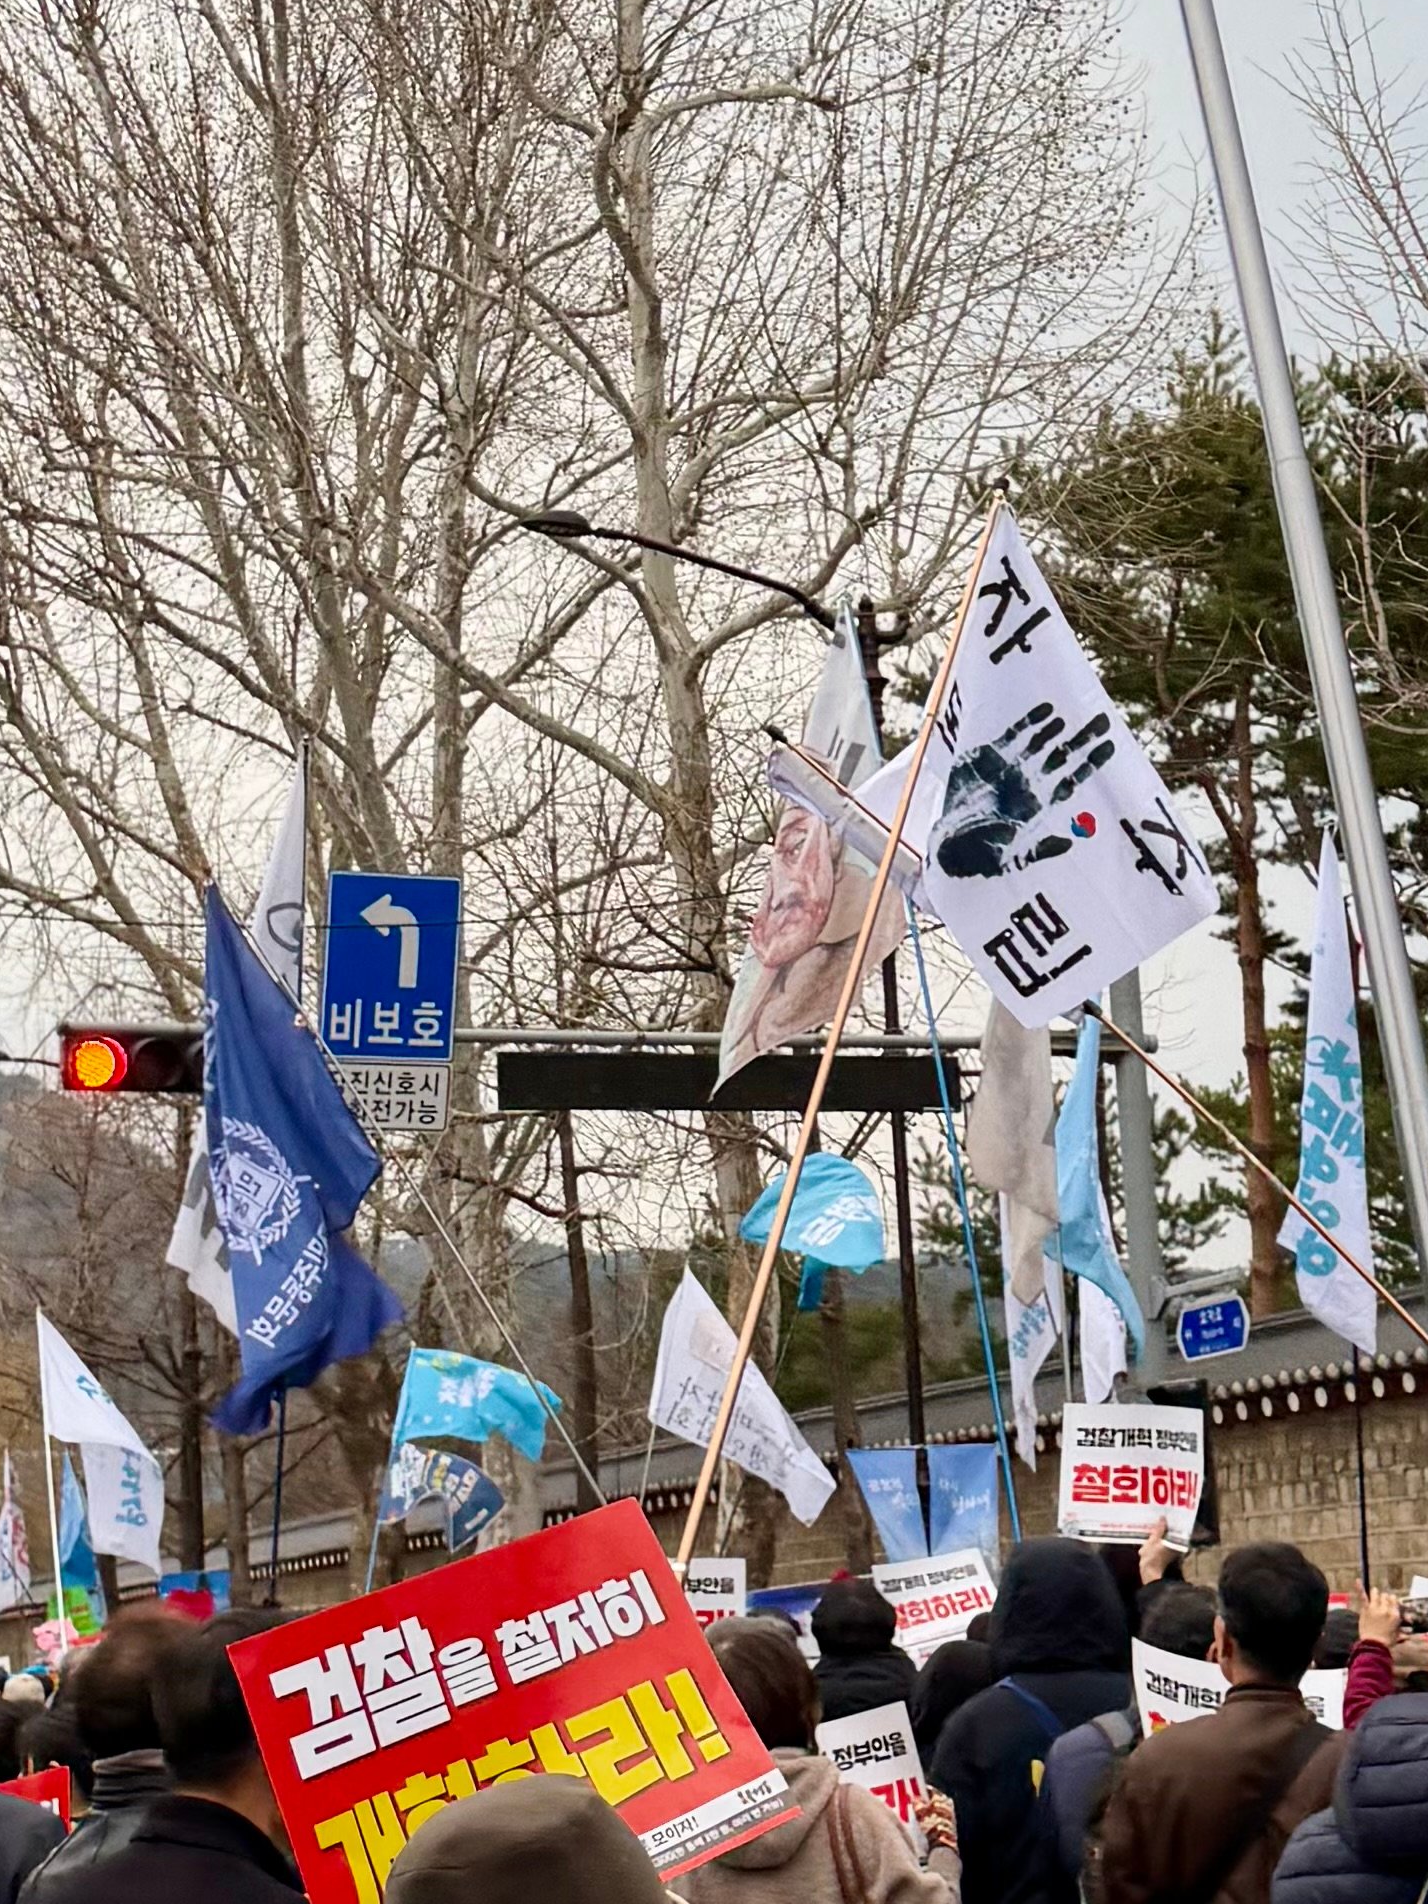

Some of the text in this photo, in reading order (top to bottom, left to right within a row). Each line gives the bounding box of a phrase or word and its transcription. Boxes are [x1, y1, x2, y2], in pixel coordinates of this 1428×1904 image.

[330, 998, 444, 1048] 비보호
[333, 1070, 440, 1096] 진신호시
[1076, 1427, 1153, 1448] 검찰개혁
[1072, 1463, 1199, 1511] 철회하라!
[268, 1568, 667, 1781] 검찰을 철저히
[1144, 1668, 1223, 1710] 검찰개혁
[832, 1731, 908, 1772] 정부안을
[650, 1815, 700, 1847] 모이자!
